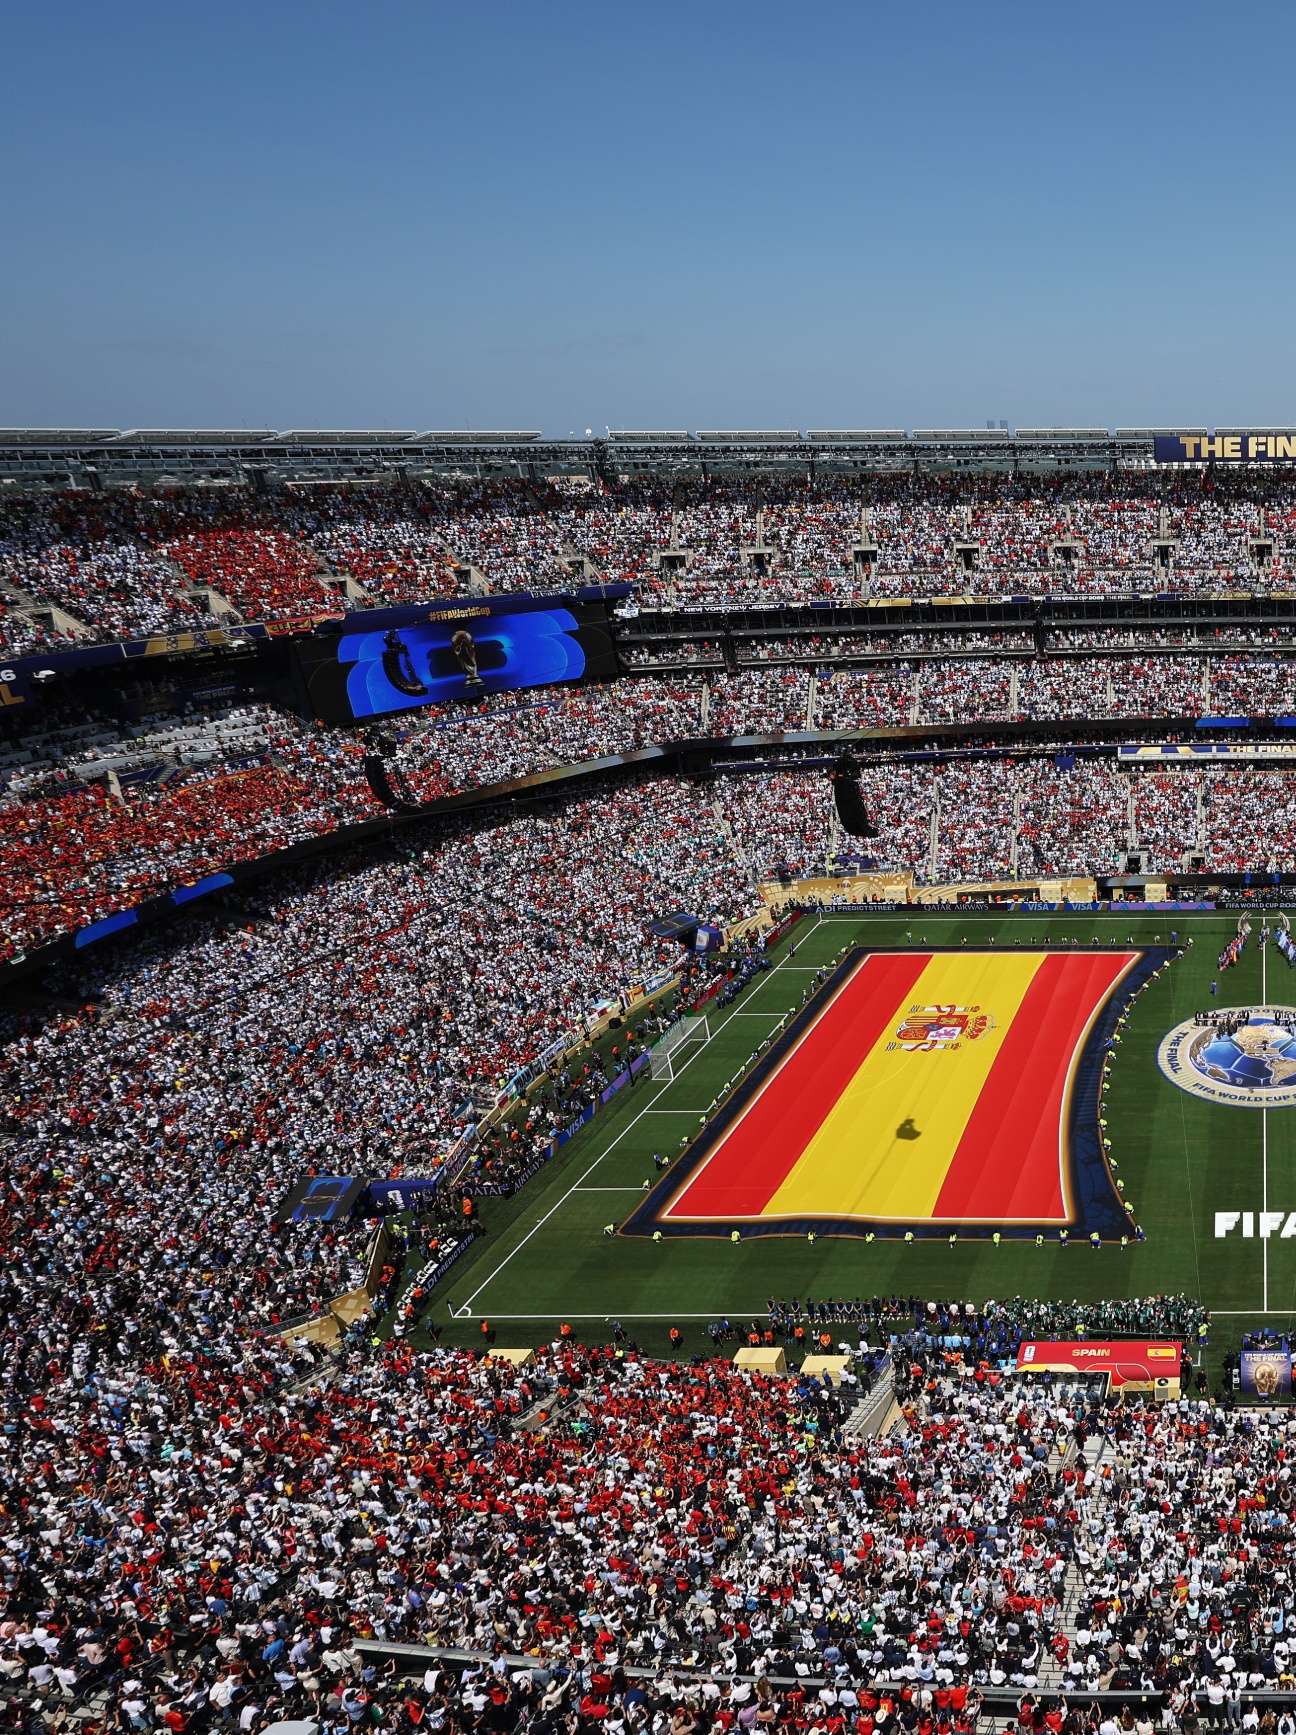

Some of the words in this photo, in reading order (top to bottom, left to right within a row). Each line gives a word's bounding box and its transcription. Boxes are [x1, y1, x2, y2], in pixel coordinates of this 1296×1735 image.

[1180, 436, 1242, 459] THE
[429, 606, 491, 622] #FIFAWorldCup
[815, 904, 836, 913] ADI
[954, 903, 989, 911] AIRWAYS
[1027, 903, 1050, 911] VISA
[1071, 903, 1093, 911] VISA
[1170, 1031, 1189, 1048] THE
[1166, 1049, 1183, 1074] FINAL
[1192, 1082, 1216, 1096] FIFA
[1218, 1091, 1263, 1102] WORLD
[1265, 1094, 1290, 1102] CUP
[565, 1115, 585, 1138] VISA
[514, 1156, 545, 1193] AIRWAYS
[1071, 1348, 1111, 1357] SPAIN
